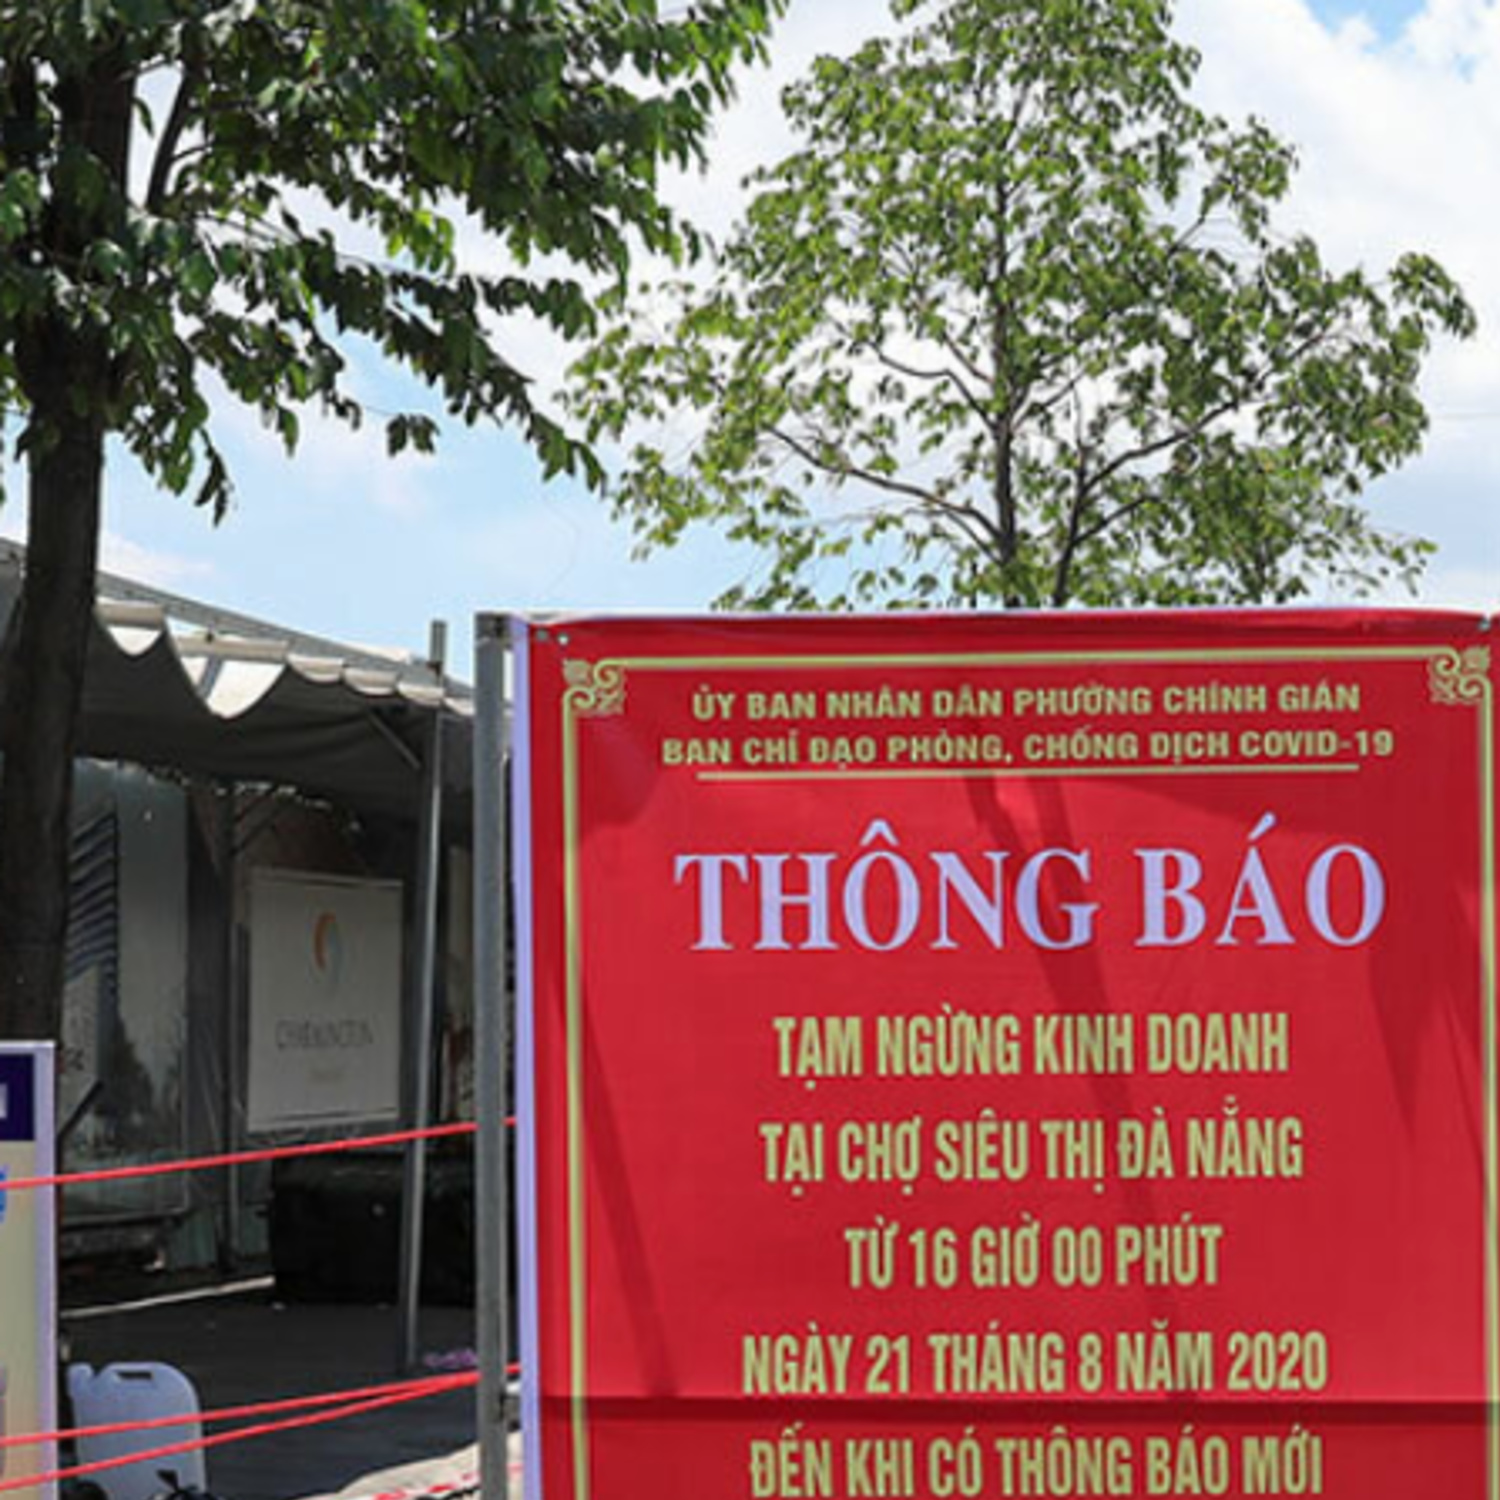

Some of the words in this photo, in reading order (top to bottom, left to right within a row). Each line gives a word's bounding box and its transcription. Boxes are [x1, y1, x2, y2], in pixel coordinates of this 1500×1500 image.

[693, 684, 736, 720] ỦY
[746, 692, 816, 720] BAN
[826, 685, 921, 718] NHÂN
[932, 685, 1003, 717] DÂN
[1013, 683, 1152, 716] PHƯỜNG
[1162, 682, 1267, 714] CHÍNH
[1278, 681, 1360, 712] GIÁN
[662, 738, 732, 765] BAN
[742, 729, 798, 765] CHỈ
[808, 736, 876, 769] ĐẠO
[1023, 728, 1139, 761] CHỐNG
[1149, 731, 1230, 763] DỊCH
[1239, 729, 1394, 758] COVID-19
[674, 819, 1099, 951] THÔNG
[1134, 812, 1384, 946] BÁO
[773, 1016, 862, 1090] TẠM
[877, 1003, 1021, 1076] NGỪNG
[1034, 1013, 1133, 1075] KINH
[1147, 1012, 1288, 1073] DOANH
[759, 1122, 824, 1196] TẠI
[838, 1116, 922, 1195] CHỢ
[935, 1108, 1028, 1181] SIÊU
[1040, 1119, 1104, 1193] THỊ
[1117, 1106, 1174, 1179] ĐÀ
[844, 1215, 899, 1289] TỪ
[908, 1227, 958, 1288] 16
[971, 1213, 1041, 1287] GIỜ
[1053, 1226, 1102, 1287] 00
[1116, 1211, 1223, 1285] PHÚT
[742, 1320, 853, 1395] NGÀY
[865, 1335, 909, 1394] 21
[928, 1320, 1065, 1393] THÁNG
[1079, 1333, 1102, 1393] 8
[1116, 1317, 1213, 1392] NĂM
[1227, 1331, 1327, 1391] 2020
[749, 1422, 833, 1498] ĐẾN
[846, 1439, 914, 1497] KHI
[928, 1426, 983, 1497] CÓ
[995, 1425, 1132, 1496] THÔNG
[1146, 1424, 1229, 1495] BÁO
[1242, 1423, 1322, 1494] MỚI
